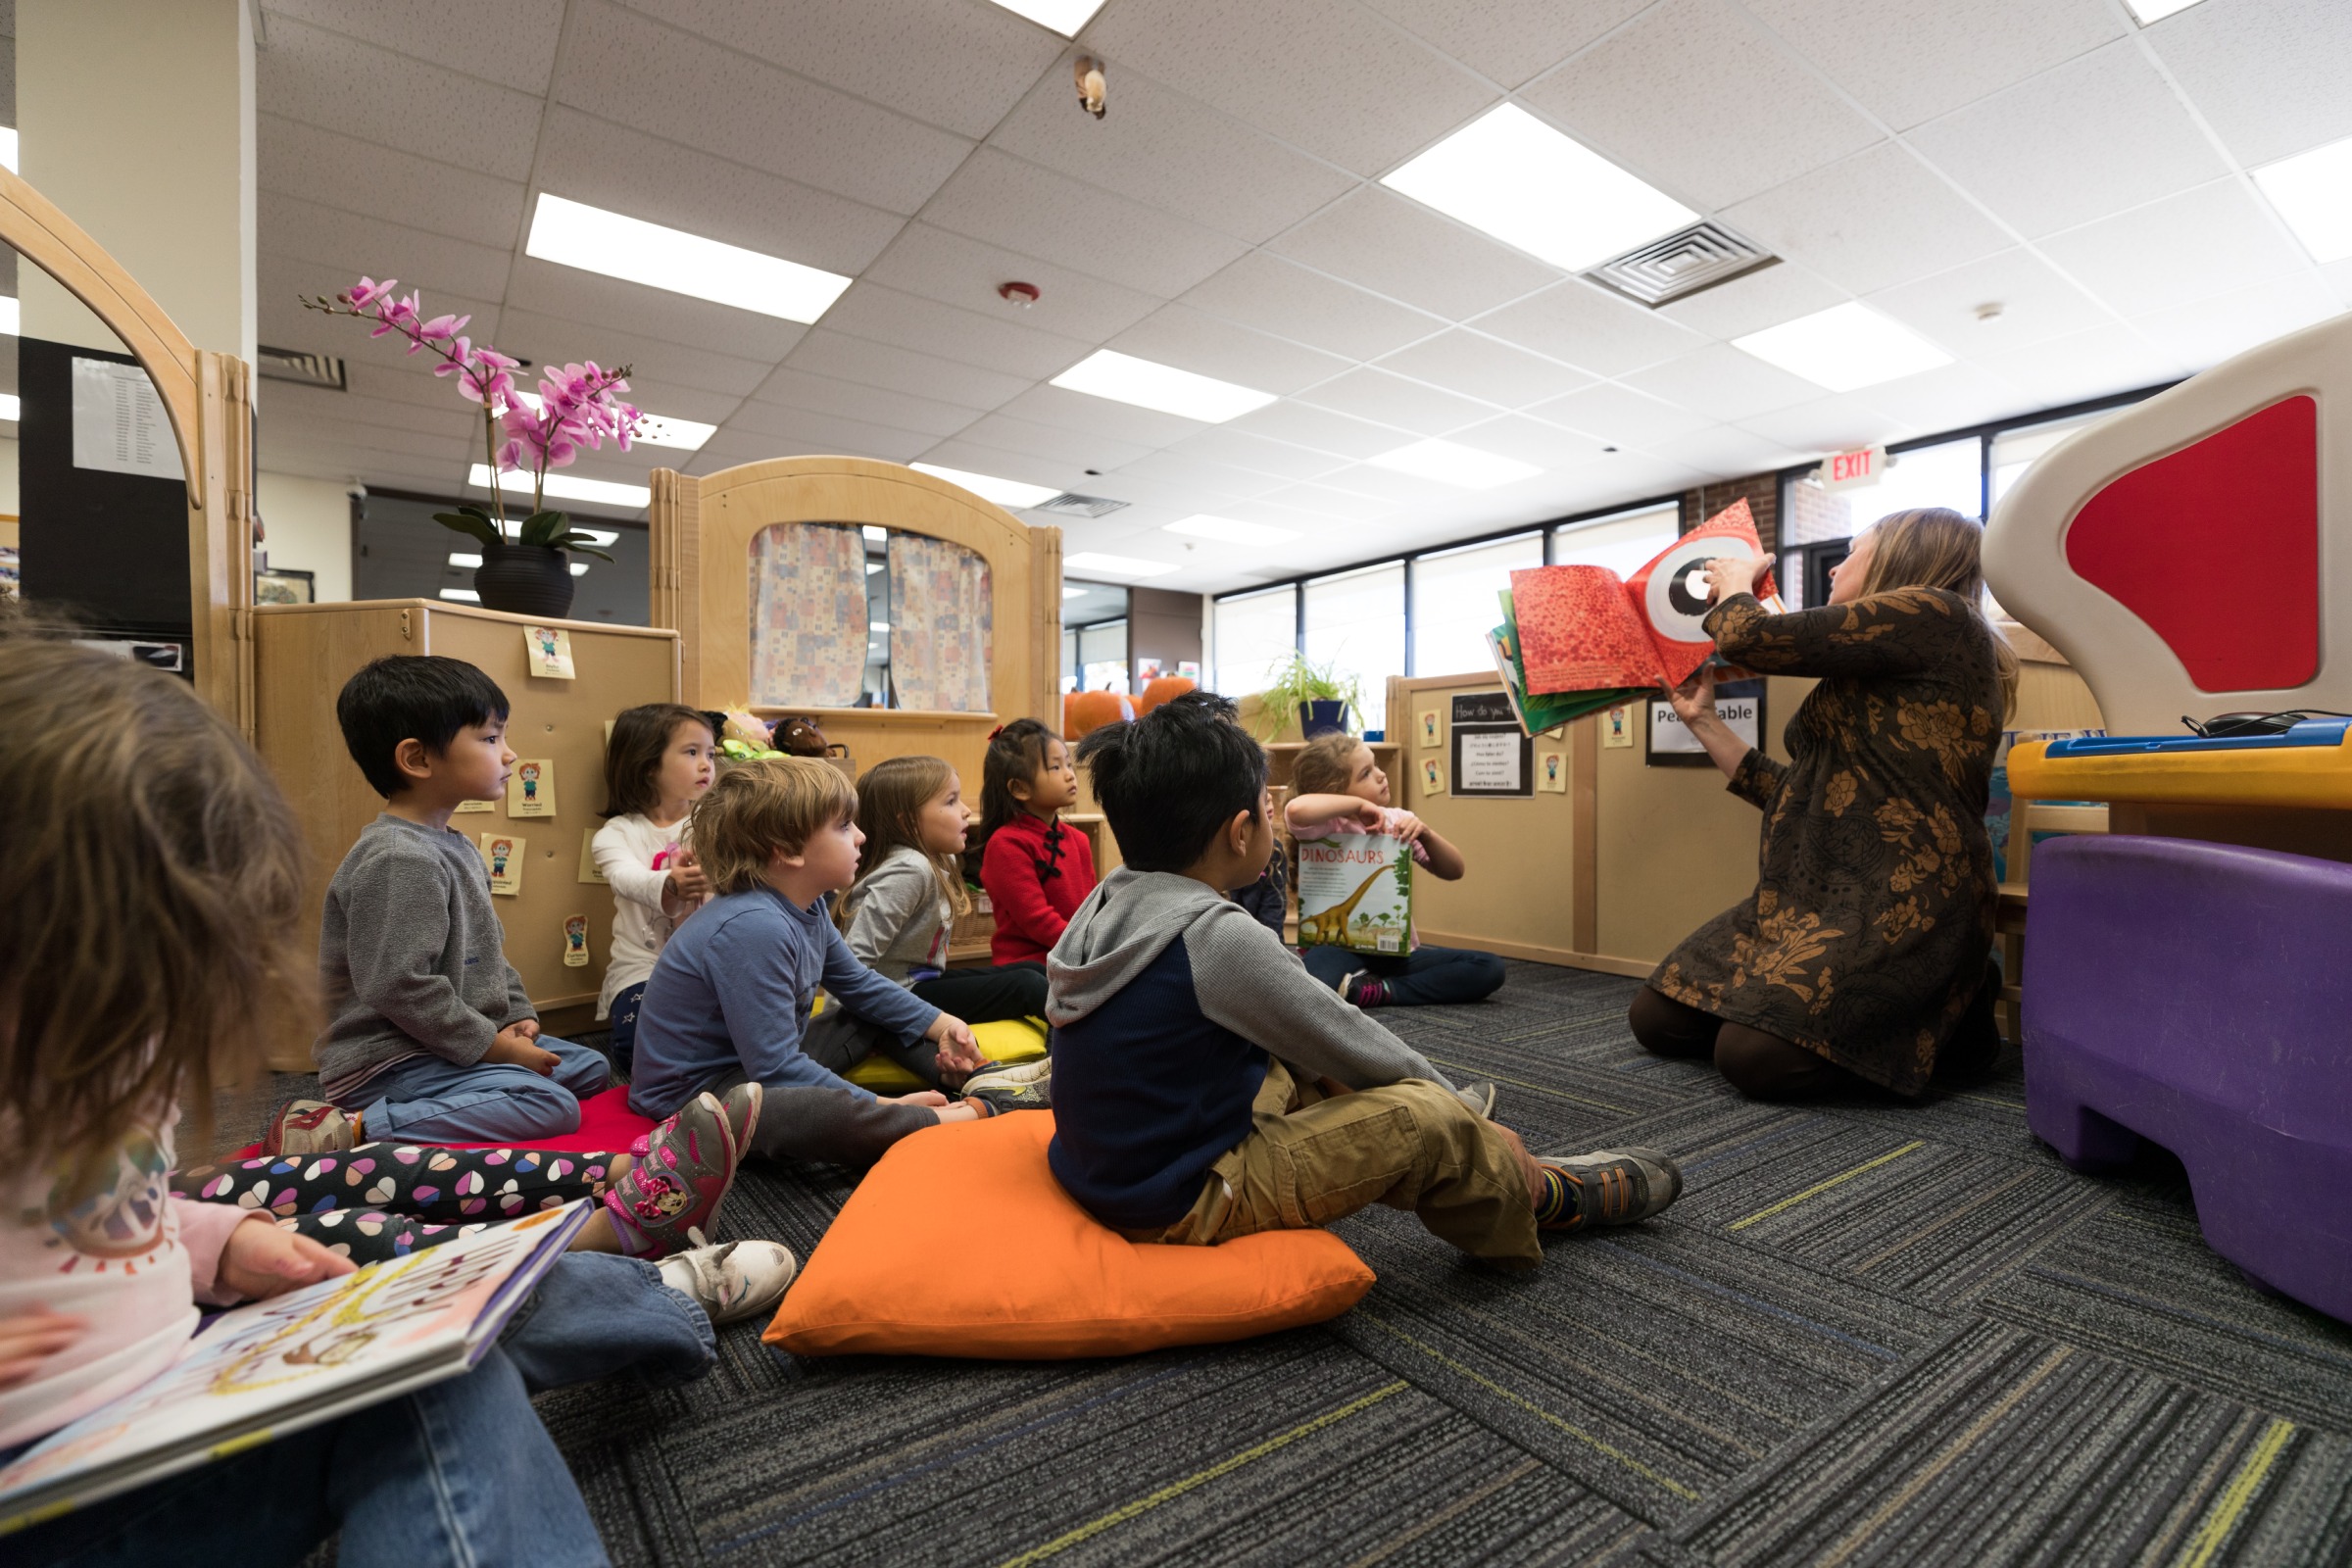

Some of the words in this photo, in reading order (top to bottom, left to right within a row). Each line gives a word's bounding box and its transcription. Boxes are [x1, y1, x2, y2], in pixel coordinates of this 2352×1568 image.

[1834, 450, 1873, 481] EXIT
[1455, 704, 1475, 720] How
[1477, 705, 1488, 716] do
[1490, 707, 1504, 720] you
[1658, 710, 1684, 722] Pea
[1716, 706, 1752, 720] able
[1301, 848, 1384, 864] DINOSAURS
